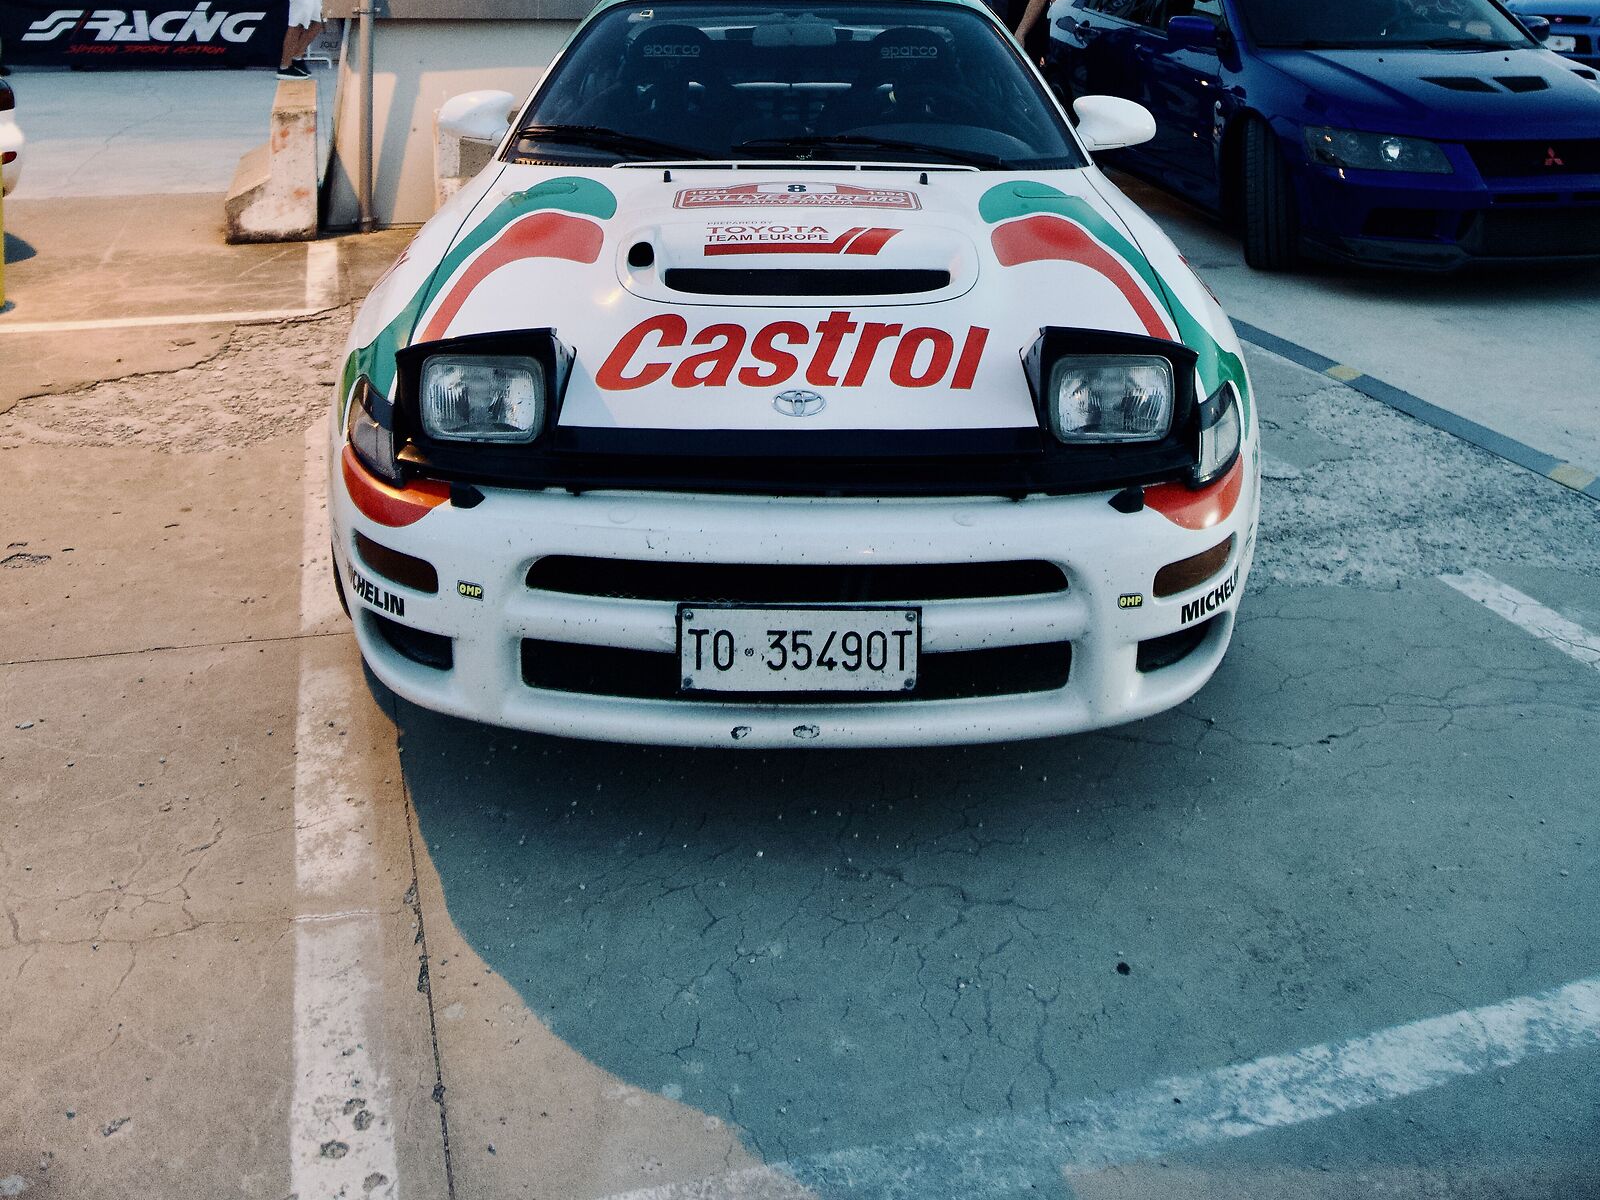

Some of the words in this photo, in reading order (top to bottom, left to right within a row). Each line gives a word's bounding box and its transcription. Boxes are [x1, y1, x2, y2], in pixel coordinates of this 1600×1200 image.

[122, 45, 170, 54] SPORT
[173, 45, 225, 55] ACTION
[643, 44, 700, 55] sparco
[881, 45, 938, 58] sparco
[787, 184, 806, 193] 8
[707, 226, 829, 234] TOYOTA
[706, 234, 753, 242] TEAM
[759, 233, 829, 241] EUROPE
[595, 311, 990, 391] Castrol
[345, 558, 405, 617] CHELIN
[459, 584, 482, 598] OMP
[1119, 596, 1142, 608] OMP
[688, 629, 735, 671] TO
[766, 629, 913, 672] 35490T
